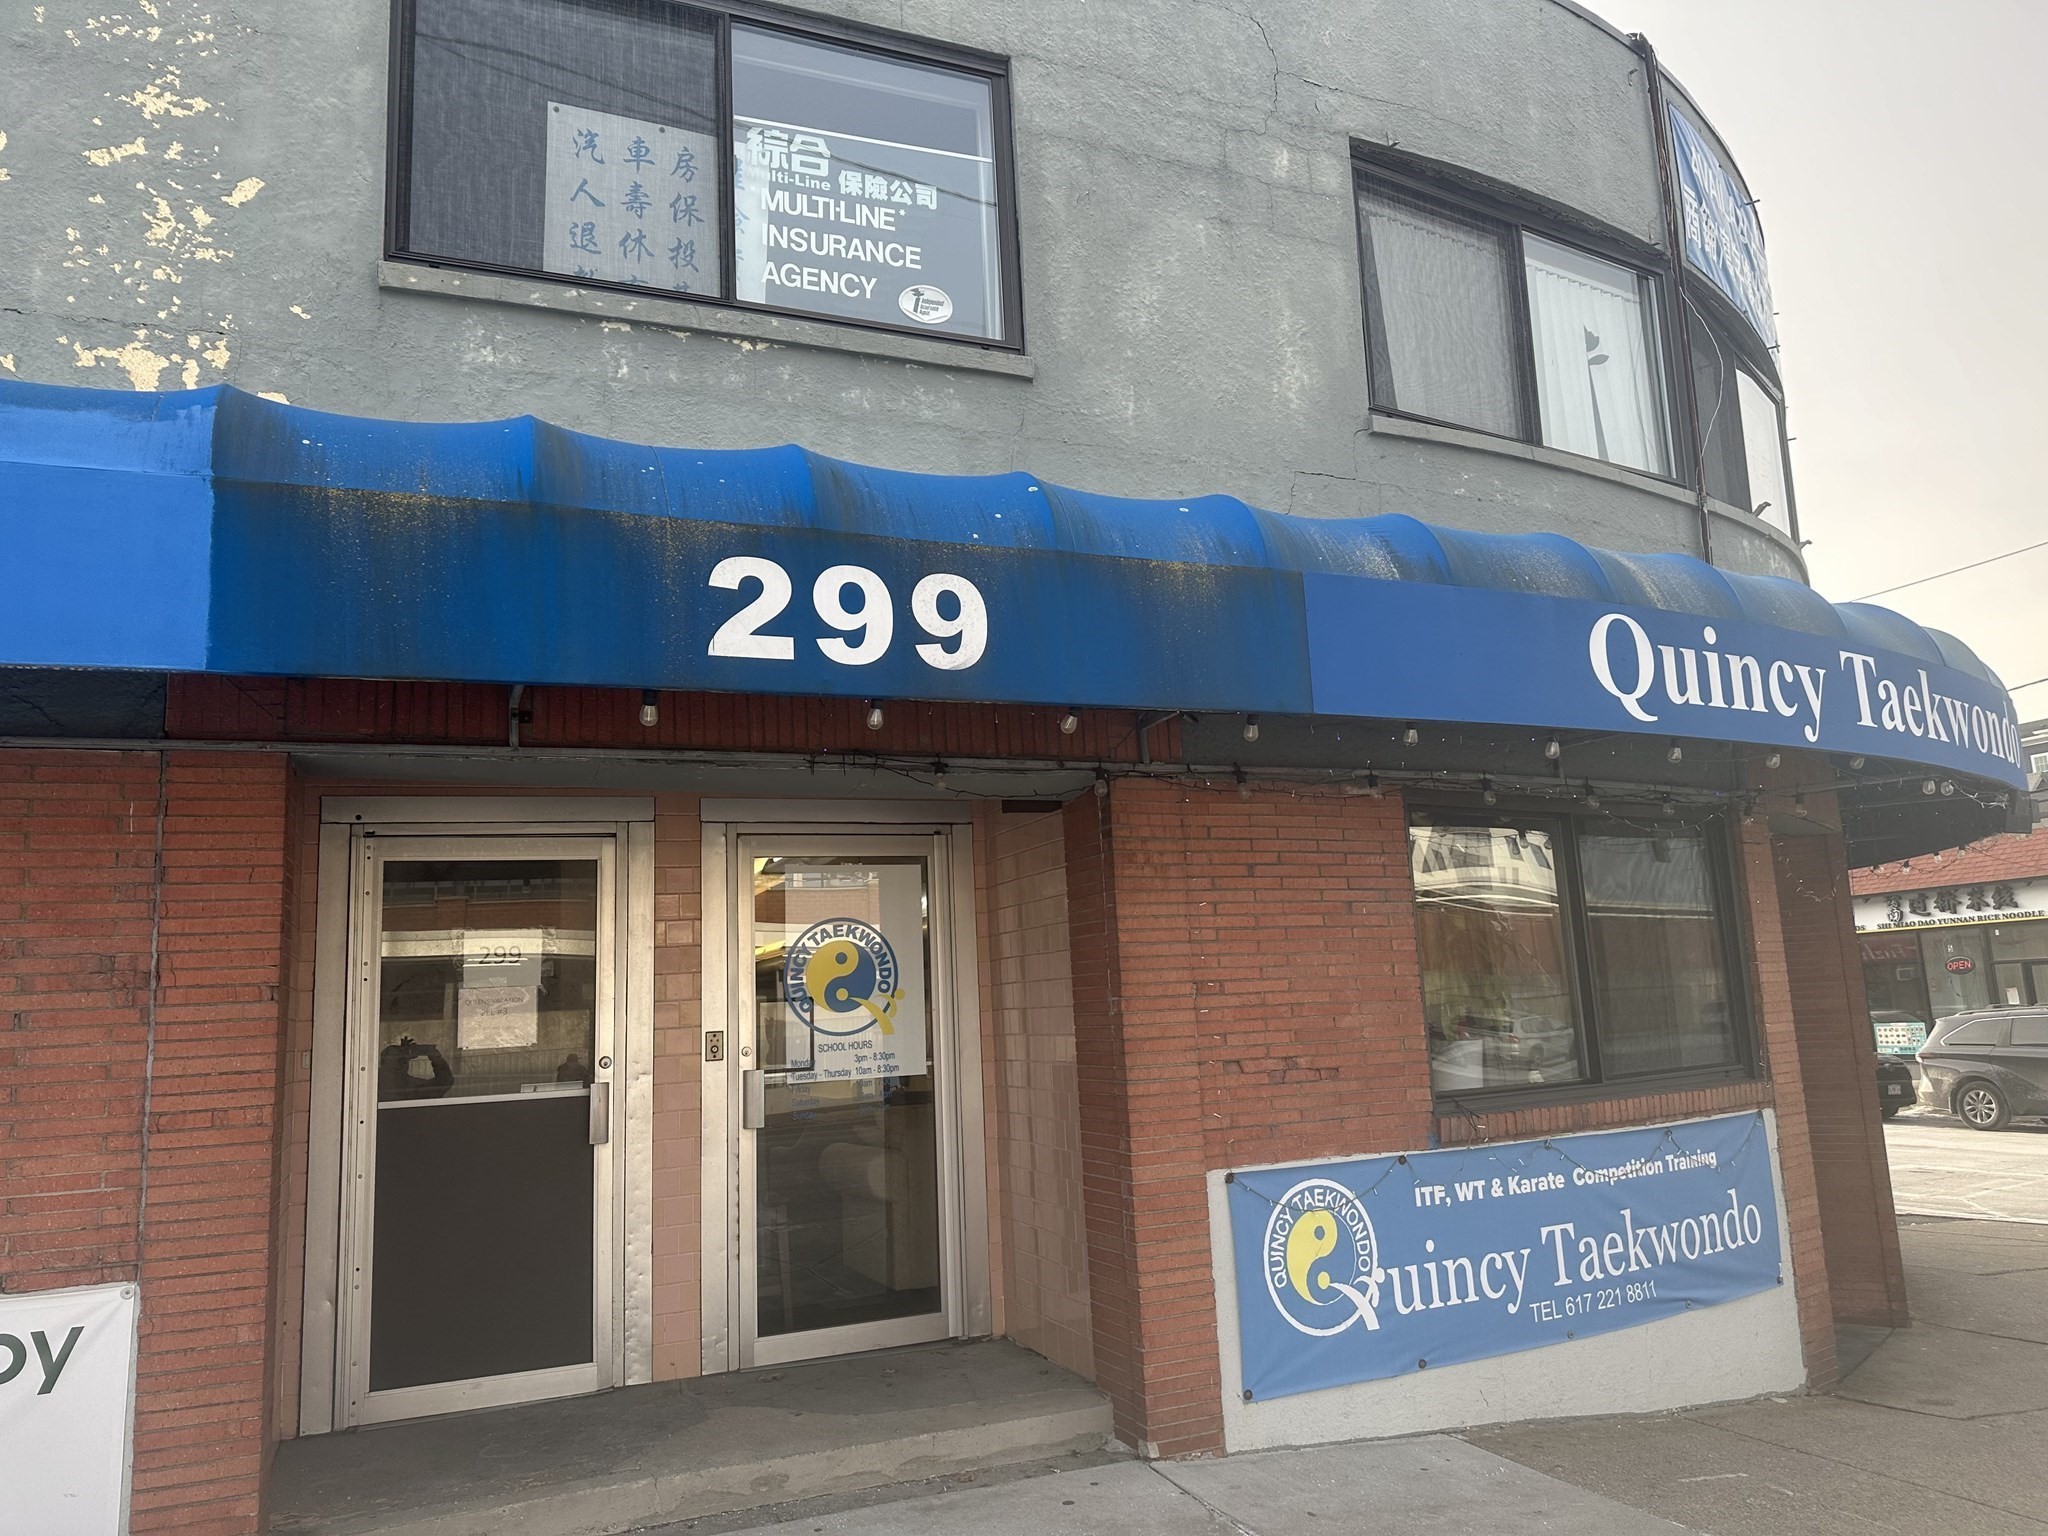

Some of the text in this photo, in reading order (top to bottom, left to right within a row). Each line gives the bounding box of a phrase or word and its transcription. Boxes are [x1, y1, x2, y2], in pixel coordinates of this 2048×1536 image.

[746, 127, 831, 177] 綜合
[838, 169, 938, 210] 保險公司
[762, 223, 922, 270] INSURANCE
[760, 261, 878, 299] AGENCY
[708, 556, 988, 671] 299
[1588, 613, 2022, 769] Quincy Taekwondo
[1893, 920, 1916, 929] MIAO
[1917, 918, 1936, 927] DAO
[1937, 915, 1976, 926] YUNNAN
[1977, 912, 2001, 922] RICE
[478, 945, 522, 965] 299
[789, 941, 813, 1013] QUINCY
[806, 924, 892, 994] TAEKWONDO
[1946, 960, 1972, 971] OPEN
[790, 1058, 816, 1068] Monday
[853, 1053, 868, 1064] 3pm
[872, 1051, 896, 1062] 8:30pm
[818, 1040, 873, 1053] SCHOOL HOURS
[790, 1071, 818, 1082] Tuesday
[824, 1068, 852, 1079] Thursday
[855, 1065, 872, 1075] 10am
[877, 1063, 900, 1074] 8:30pm
[1414, 1148, 1717, 1208] ITF, WT & Karate Competition Training
[1270, 1207, 1294, 1288] QUINCY
[1291, 1188, 1371, 1272] TAEKWONDO
[1540, 1187, 1763, 1288] Taekwondo
[1529, 1279, 1657, 1323] TEL 617 221 8811
